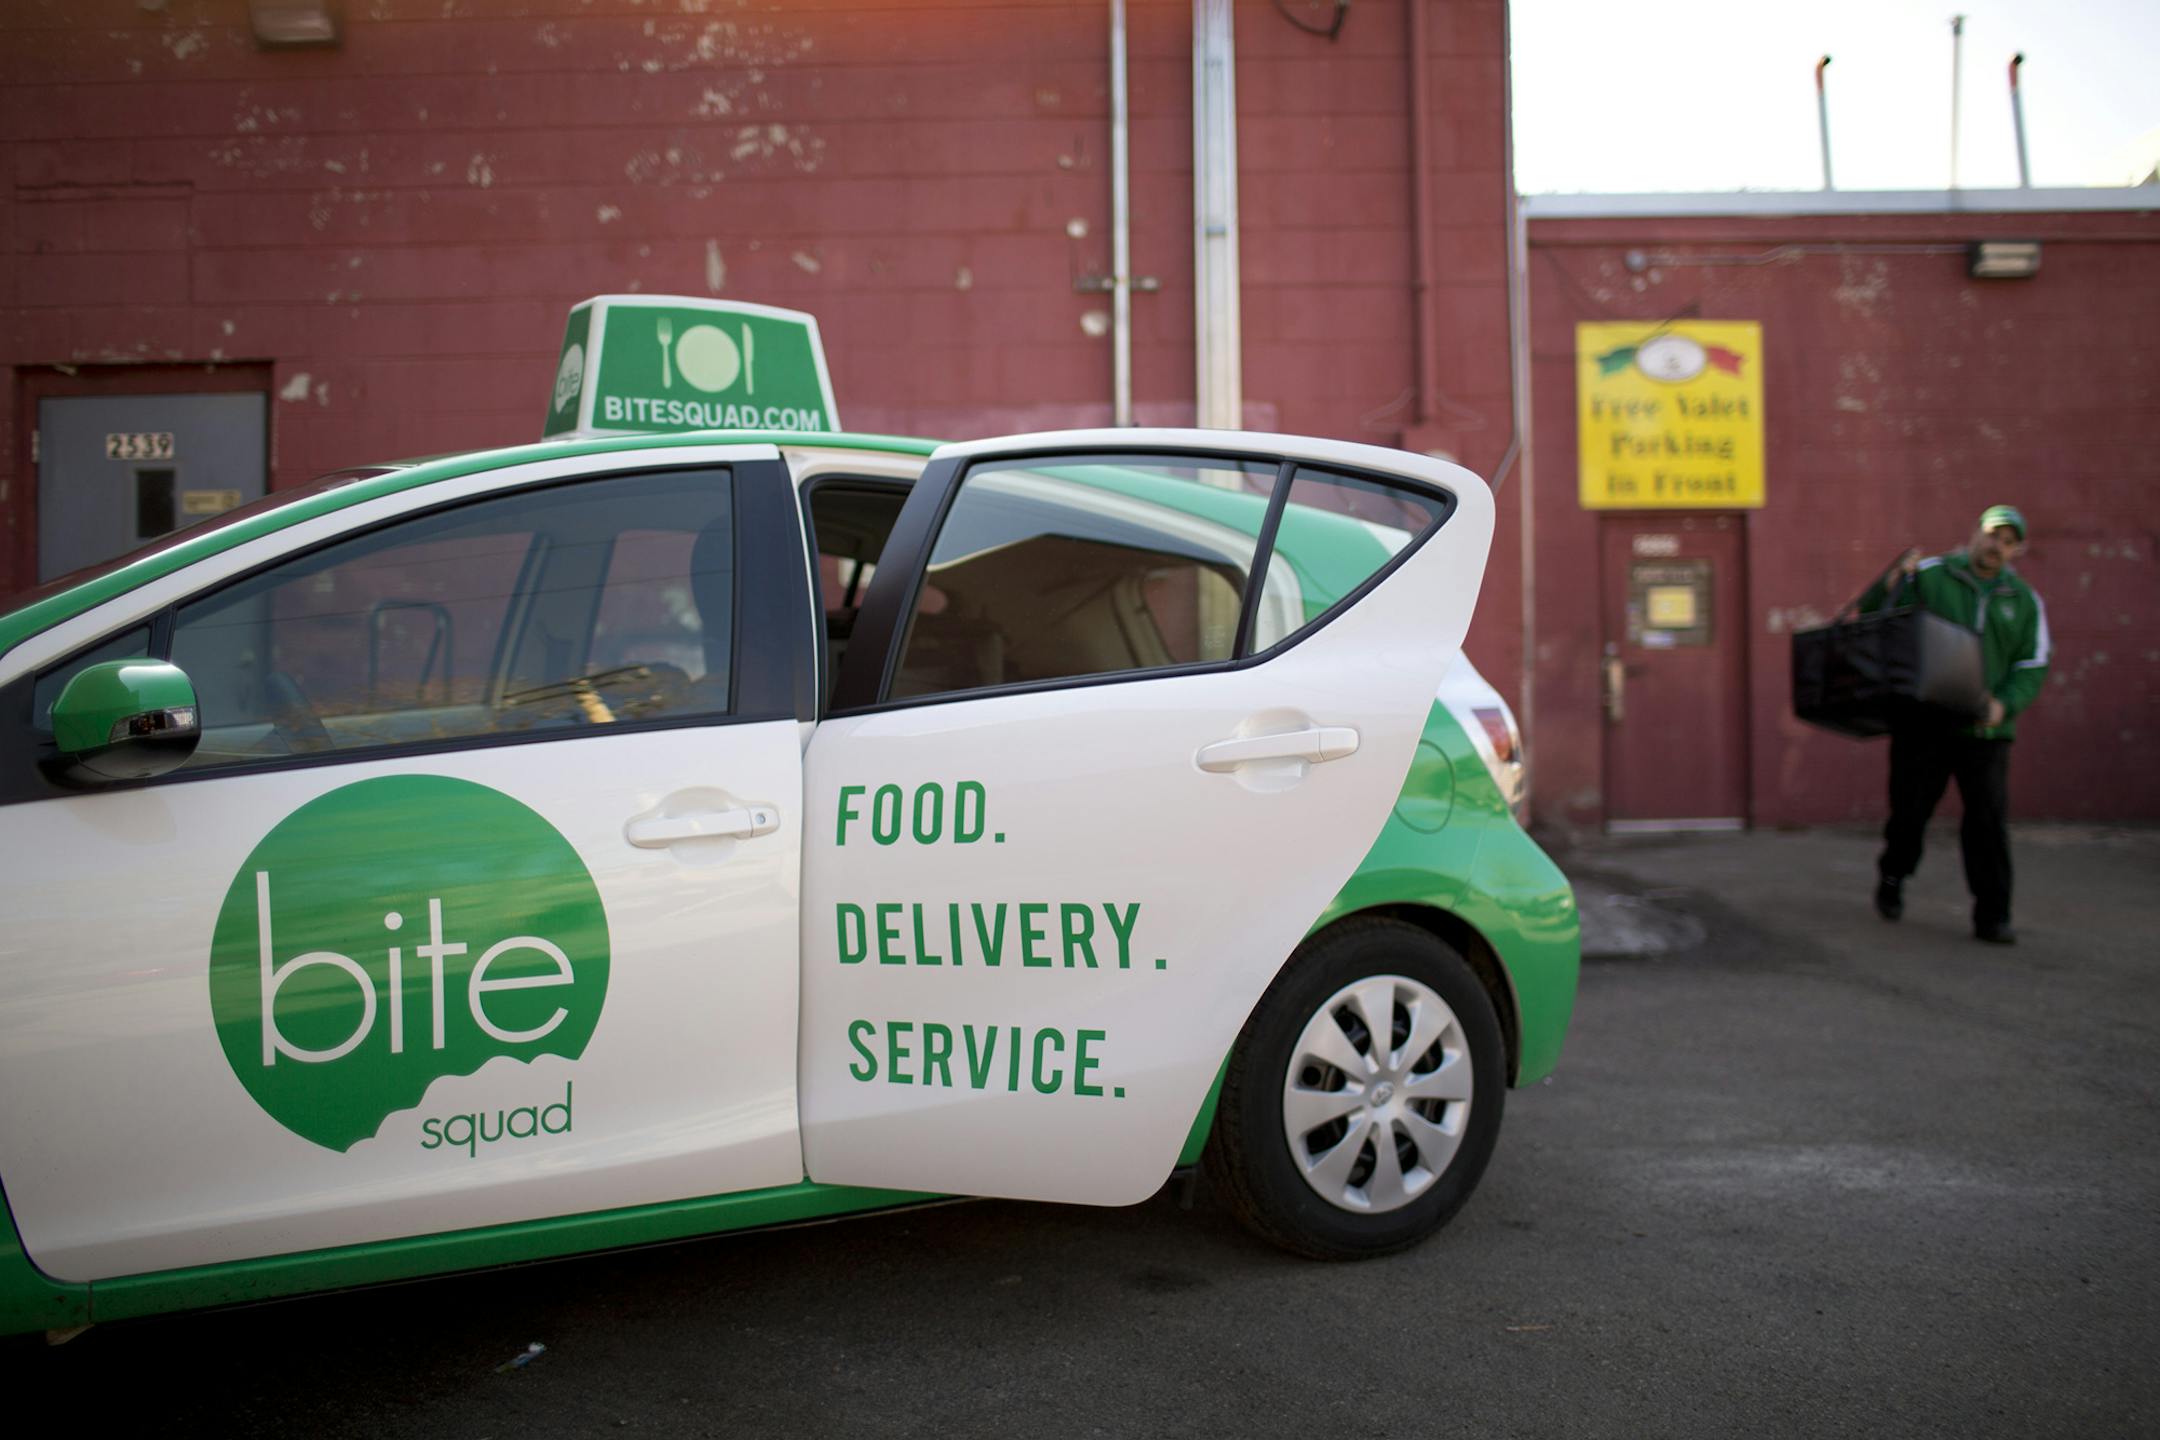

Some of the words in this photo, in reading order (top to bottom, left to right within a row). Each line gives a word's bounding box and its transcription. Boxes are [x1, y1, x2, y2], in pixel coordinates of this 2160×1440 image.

[107, 432, 173, 459] 2539
[604, 396, 821, 431] BITESQUAD.COM
[1610, 430, 1735, 461] Parking
[1653, 470, 1737, 497] Front
[836, 780, 1006, 846] FOOD.
[256, 870, 575, 1067] bite
[836, 902, 1167, 970] DELIVERY.
[847, 1019, 1126, 1098] SERVICE.
[420, 1080, 573, 1159] squad
